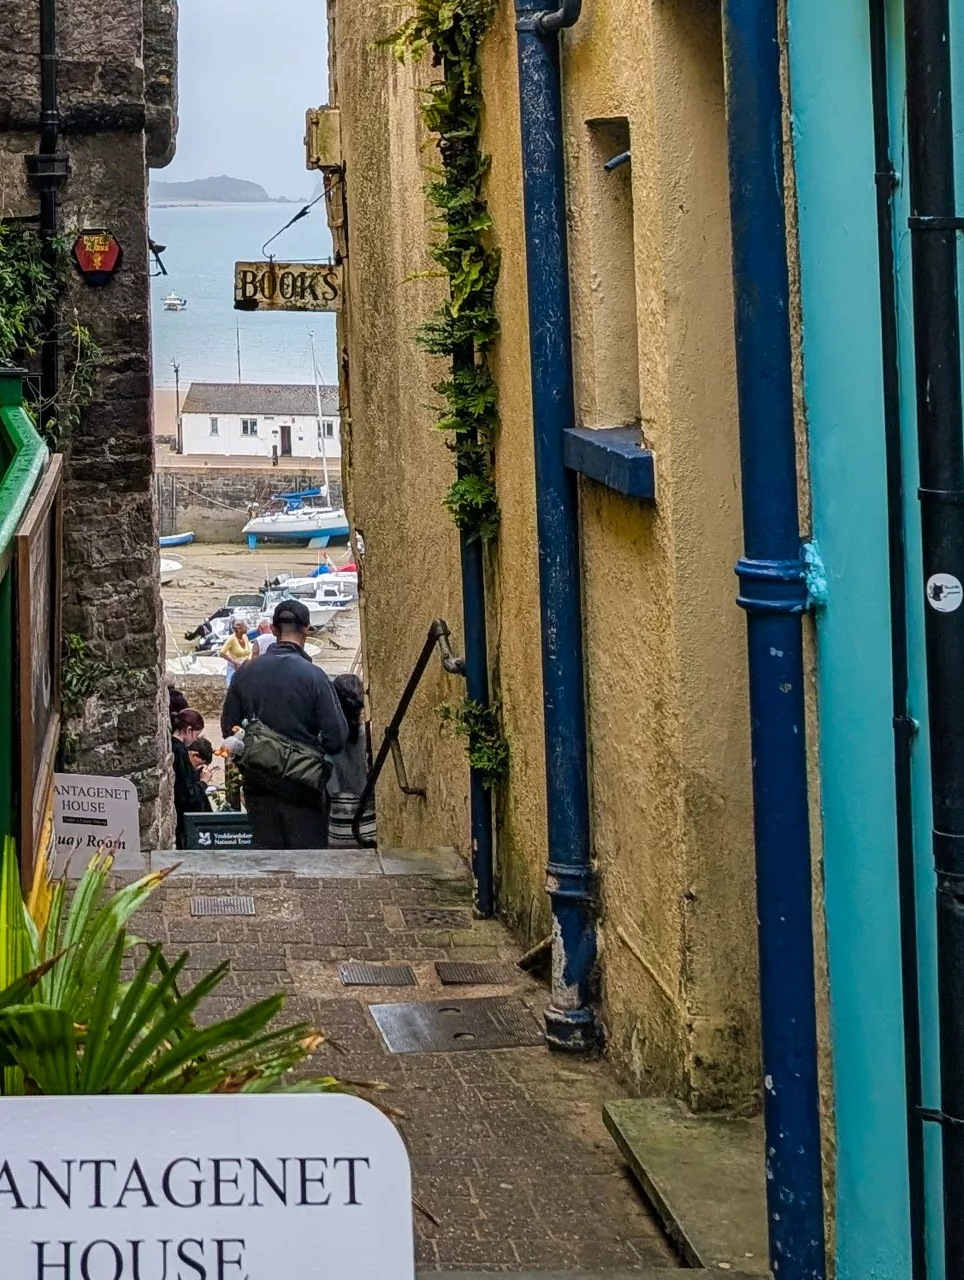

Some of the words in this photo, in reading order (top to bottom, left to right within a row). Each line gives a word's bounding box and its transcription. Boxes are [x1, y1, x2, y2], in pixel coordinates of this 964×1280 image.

[241, 270, 338, 301] BOOKS
[53, 784, 130, 800] ANTAGENET
[62, 800, 106, 813] HOUSE
[56, 834, 83, 849] uay
[86, 834, 126, 850] Room
[30, 1237, 250, 1280] HOUSE
